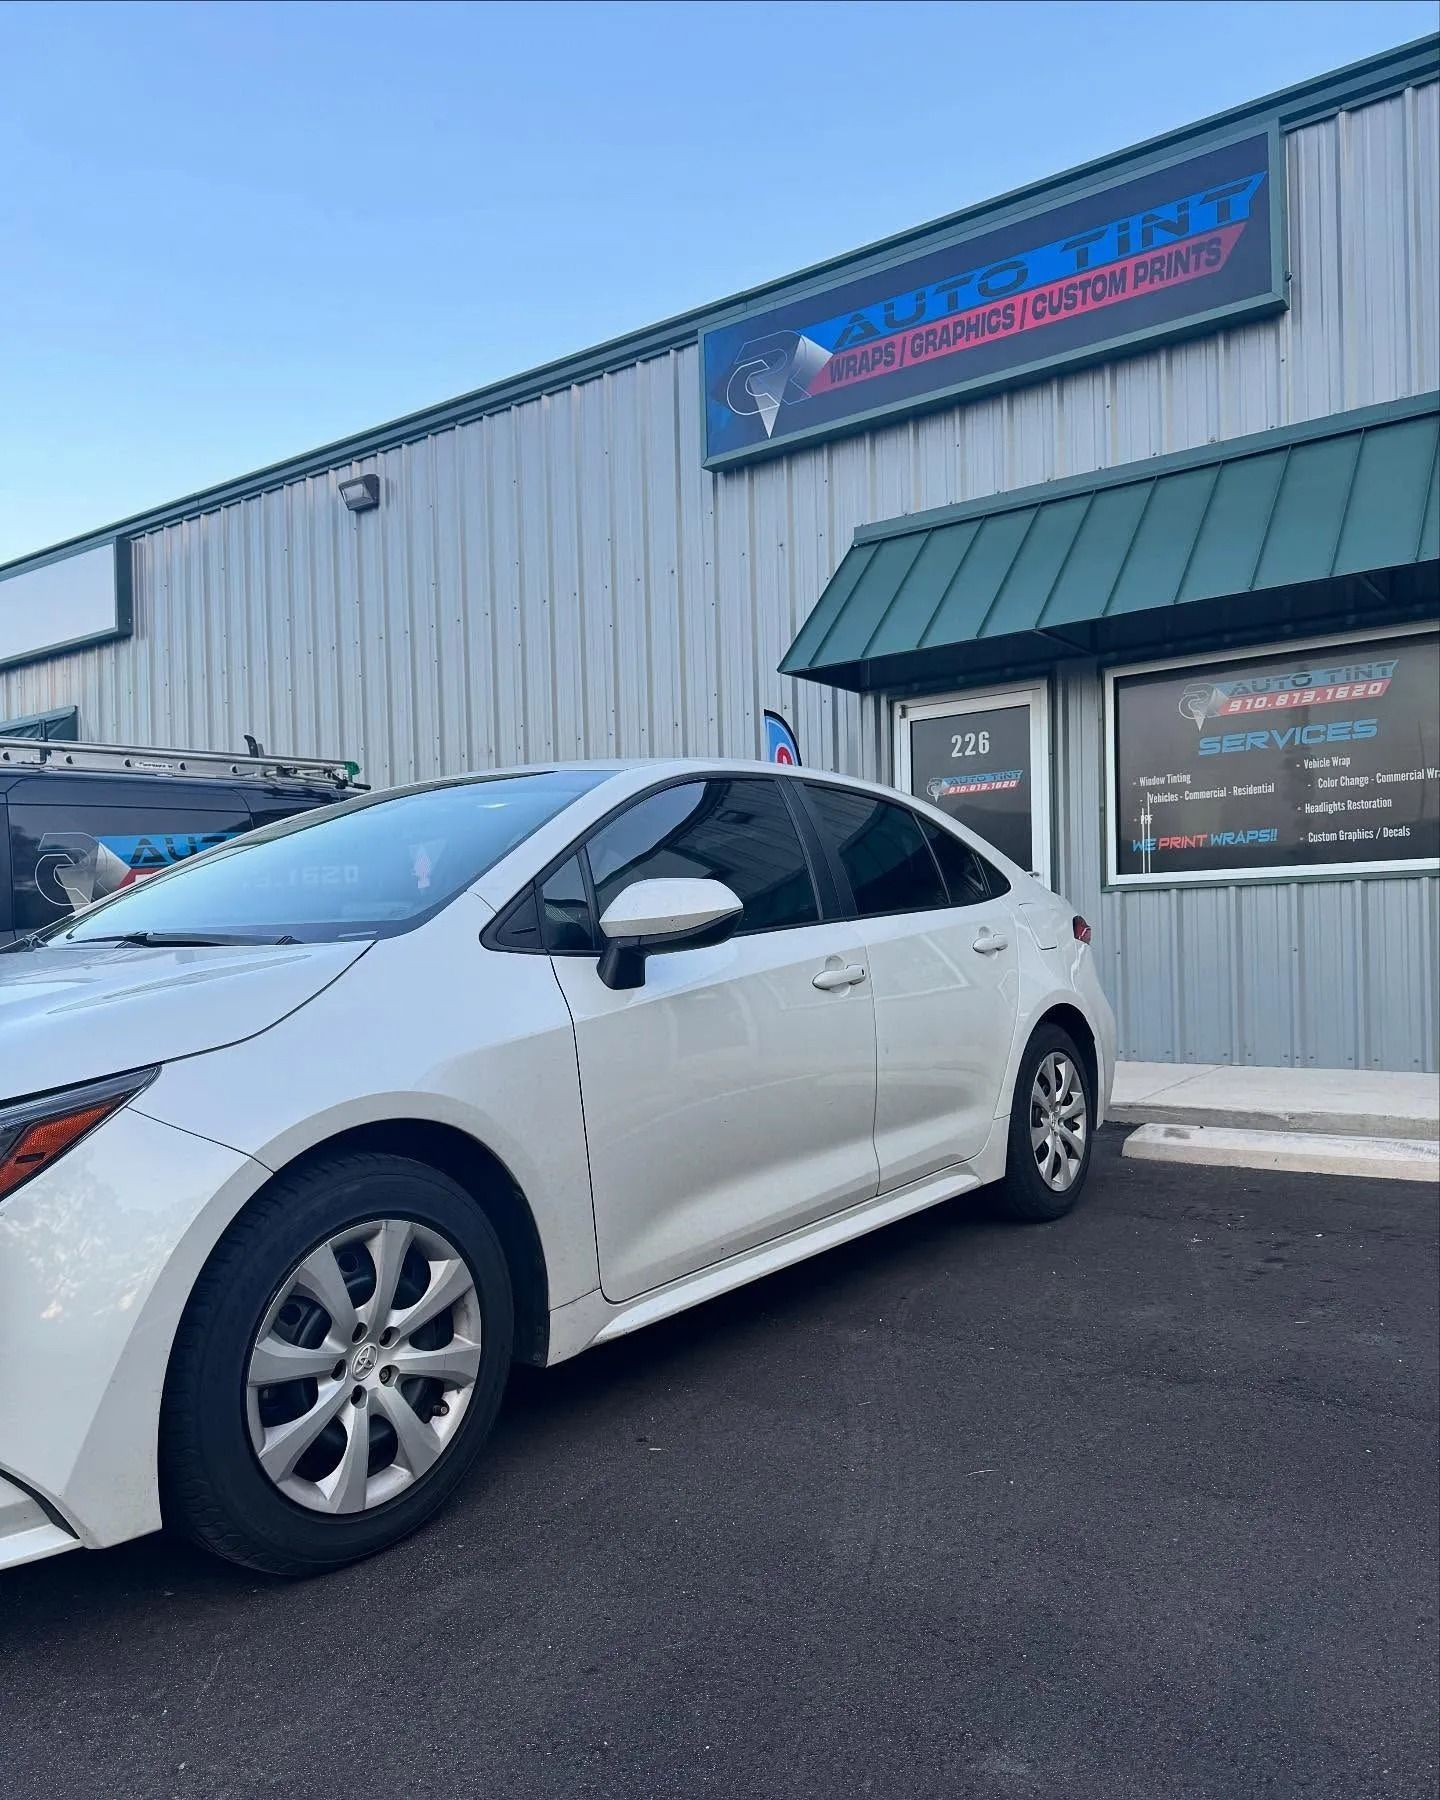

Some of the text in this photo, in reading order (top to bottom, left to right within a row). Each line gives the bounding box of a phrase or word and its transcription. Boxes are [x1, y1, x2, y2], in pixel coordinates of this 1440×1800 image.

[829, 340, 896, 384] WRAPS
[910, 302, 1015, 359] GRAPHICS
[1031, 266, 1128, 321] CUSTOM
[1132, 236, 1223, 291] PRINTS
[833, 259, 1029, 351] AUTO
[1226, 673, 1313, 697] AUTO
[1228, 682, 1383, 712] 910.813.1620
[951, 731, 990, 758] 226
[1198, 718, 1378, 756] SERVICES
[1303, 756, 1351, 769] Vehicle Wrap
[949, 775, 987, 785] AUTO
[1139, 772, 1192, 787] Window Tinting
[1318, 777, 1338, 789] Color
[1340, 775, 1369, 788] Change
[1376, 768, 1425, 784] Commercial
[1149, 791, 1179, 804] Vehicles
[1184, 787, 1227, 801] Commercial
[1233, 782, 1275, 796] Residential
[1305, 797, 1393, 814] Headlights Restoration
[1132, 828, 1278, 852] WE PRINT WRAPS!!
[1308, 831, 1337, 843] Custom
[1339, 828, 1374, 842] Graphics
[1383, 825, 1411, 838] Decals
